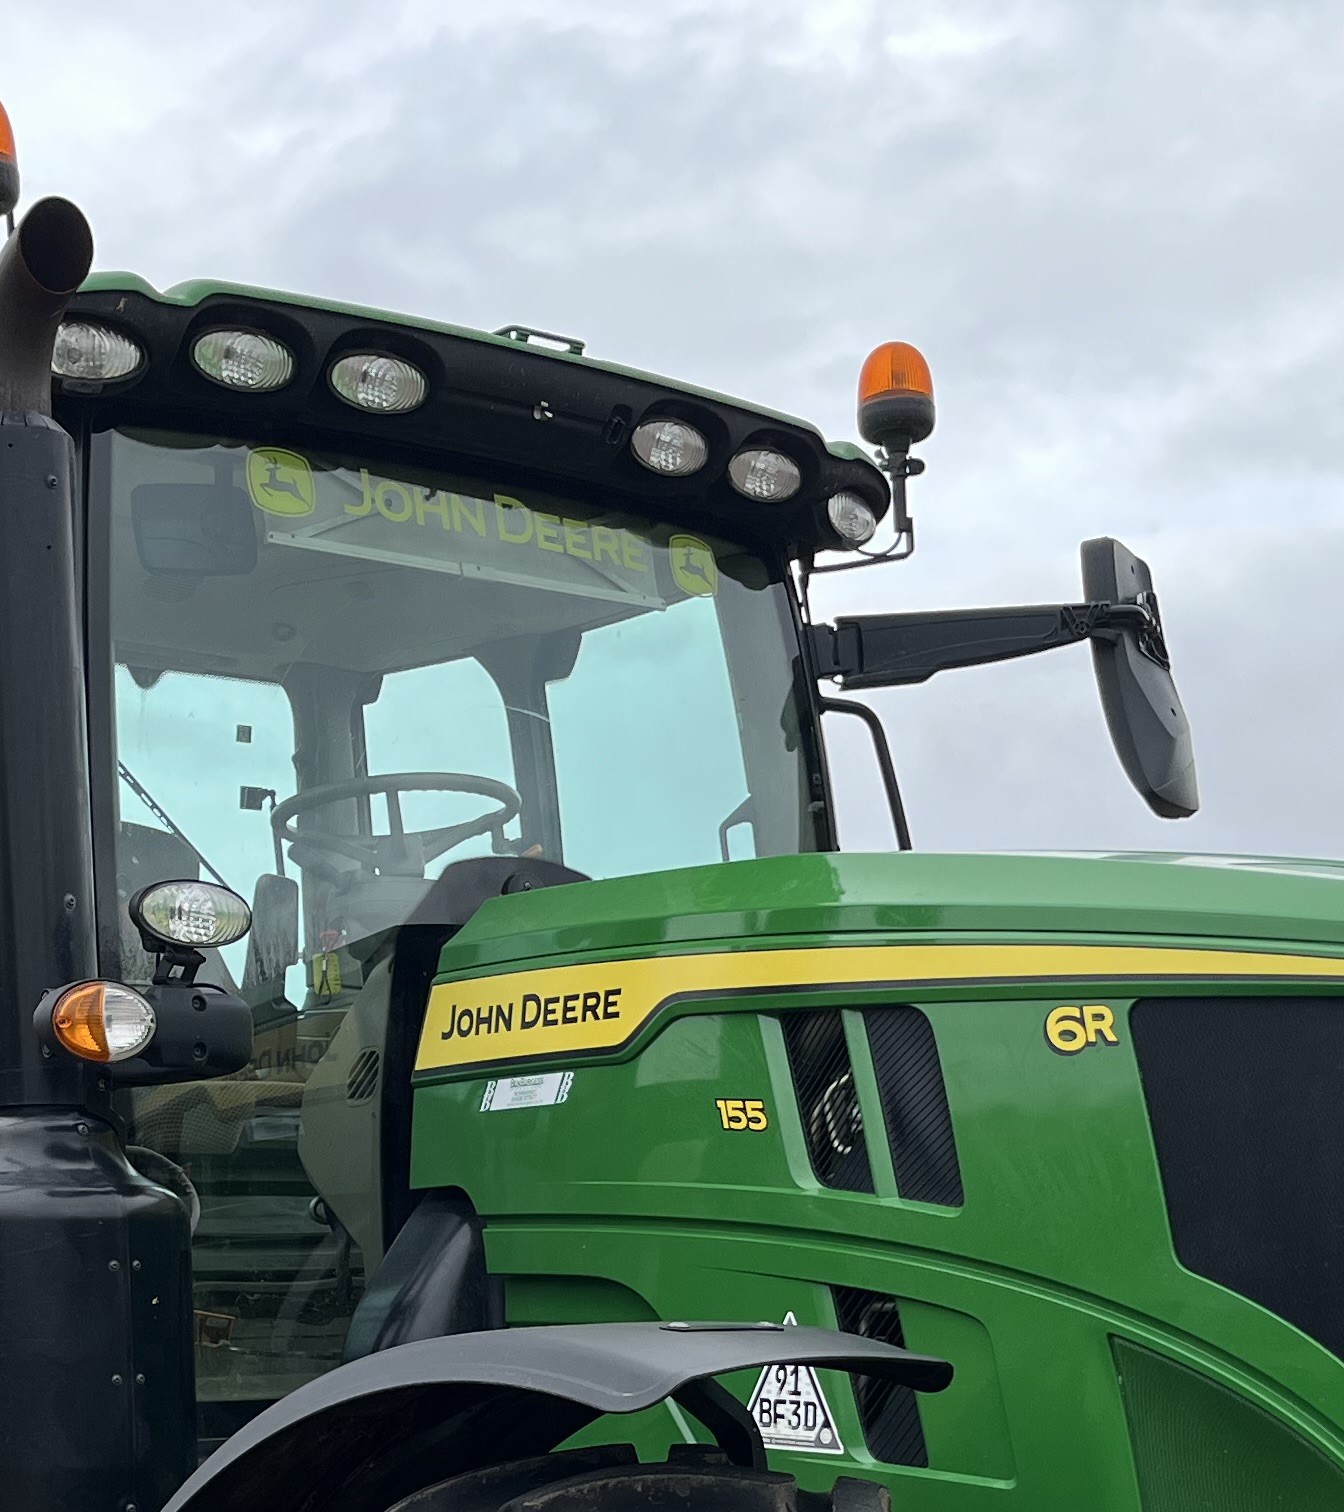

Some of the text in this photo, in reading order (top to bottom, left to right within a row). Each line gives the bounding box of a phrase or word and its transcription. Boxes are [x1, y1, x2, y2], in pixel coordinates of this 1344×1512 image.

[344, 468, 649, 573] JOHN DEERE
[441, 987, 623, 1041] JOHN DEERE
[1043, 1004, 1120, 1057] 6R
[714, 1097, 769, 1132] 155
[775, 1364, 802, 1396] 91
[758, 1397, 817, 1432] BF3D
